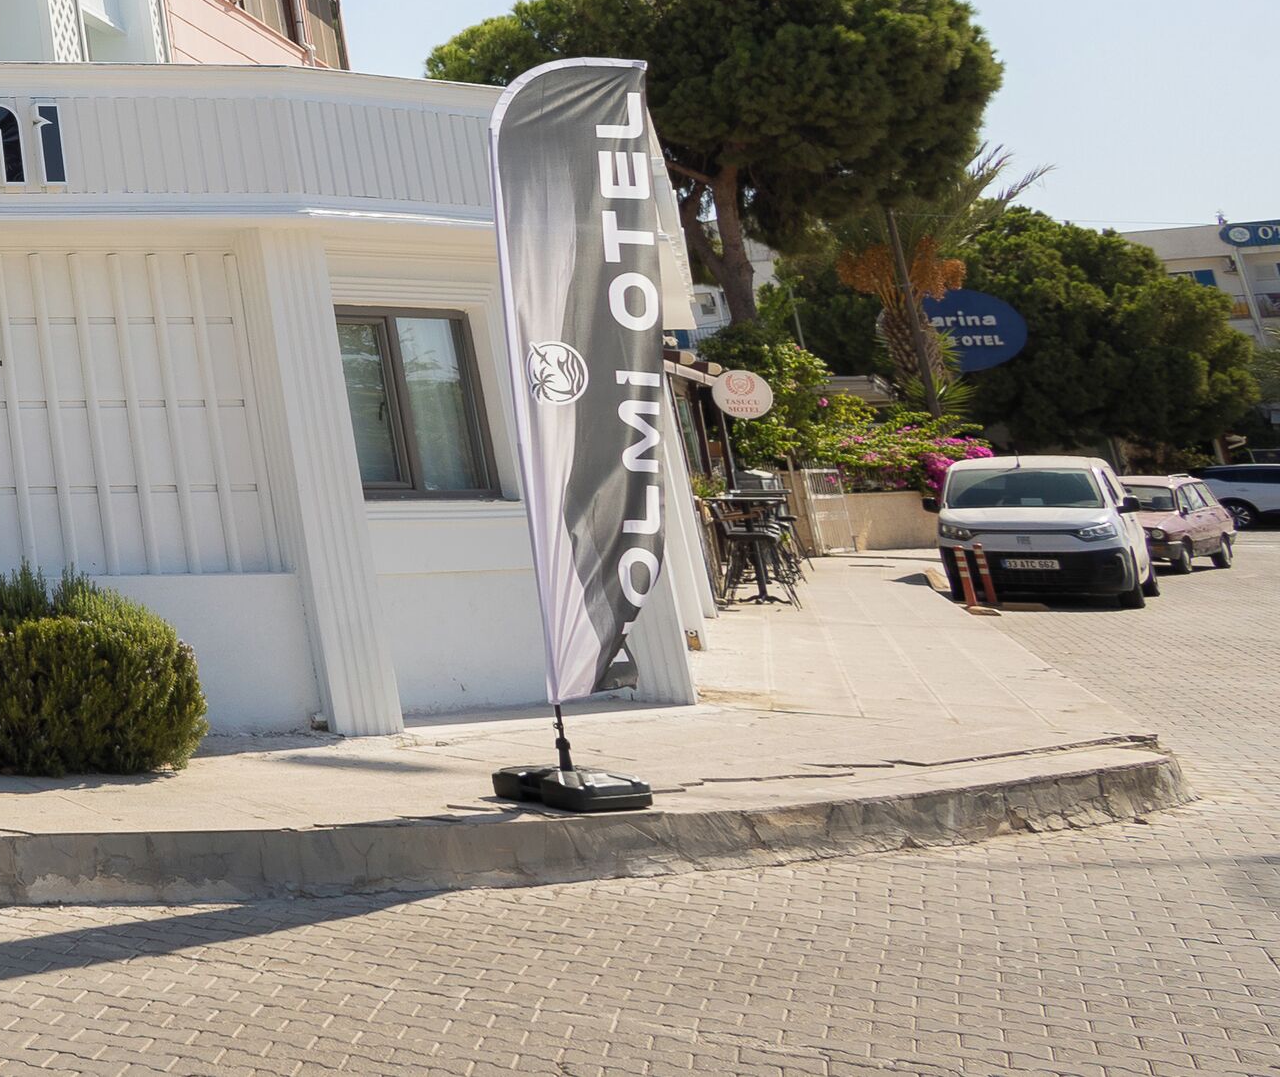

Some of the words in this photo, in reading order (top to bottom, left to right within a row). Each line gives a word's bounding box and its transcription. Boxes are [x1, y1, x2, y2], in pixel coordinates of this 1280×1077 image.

[596, 92, 660, 331] OTEL
[930, 311, 997, 327] arina
[1007, 560, 1017, 568] 33
